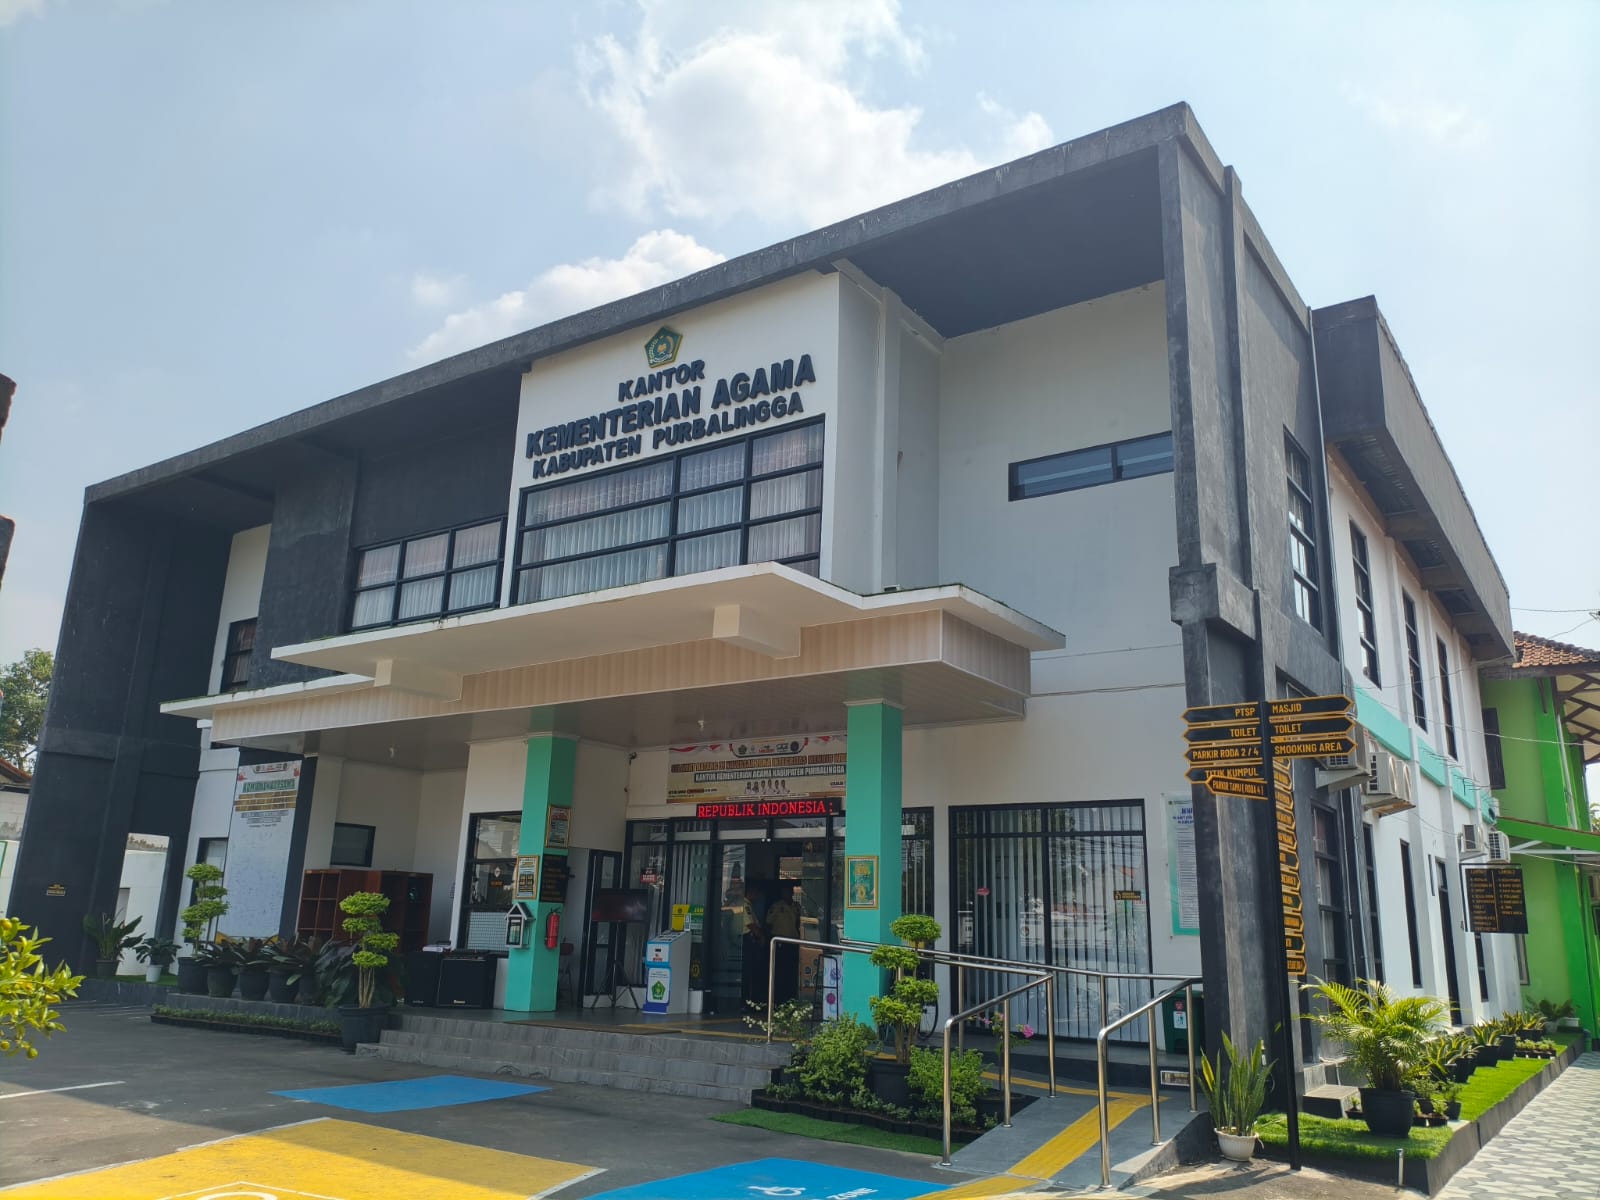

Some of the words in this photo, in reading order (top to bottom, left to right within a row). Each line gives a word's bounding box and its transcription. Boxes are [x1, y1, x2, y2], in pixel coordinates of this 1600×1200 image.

[618, 359, 705, 402] KANTOR
[526, 386, 701, 459] KEMENTERIAN
[711, 354, 816, 409] AGAMA
[532, 434, 642, 479] KABUPATEN
[652, 392, 804, 449] PURBALINGGA
[1234, 707, 1255, 717] PTSP
[1272, 703, 1302, 714] MASJID
[1230, 727, 1257, 737] TOILET
[1274, 724, 1302, 734] TOILET
[1192, 749, 1219, 760] PARKIR
[1220, 748, 1239, 758] RODA
[1241, 748, 1246, 757] 2
[1253, 747, 1259, 756] 4
[1274, 744, 1317, 755] SMOOKING
[1319, 742, 1342, 752] AREA
[695, 772, 716, 782] KANTOR
[716, 770, 752, 780] KEMENTERIAN
[752, 768, 772, 779] AGAMA
[772, 767, 804, 777] KABUPATEN
[804, 765, 845, 775] PURBALINGGA
[1227, 767, 1259, 777] KUMPUL
[697, 804, 754, 818] REPUBLIK
[757, 800, 826, 815] INDONESIA
